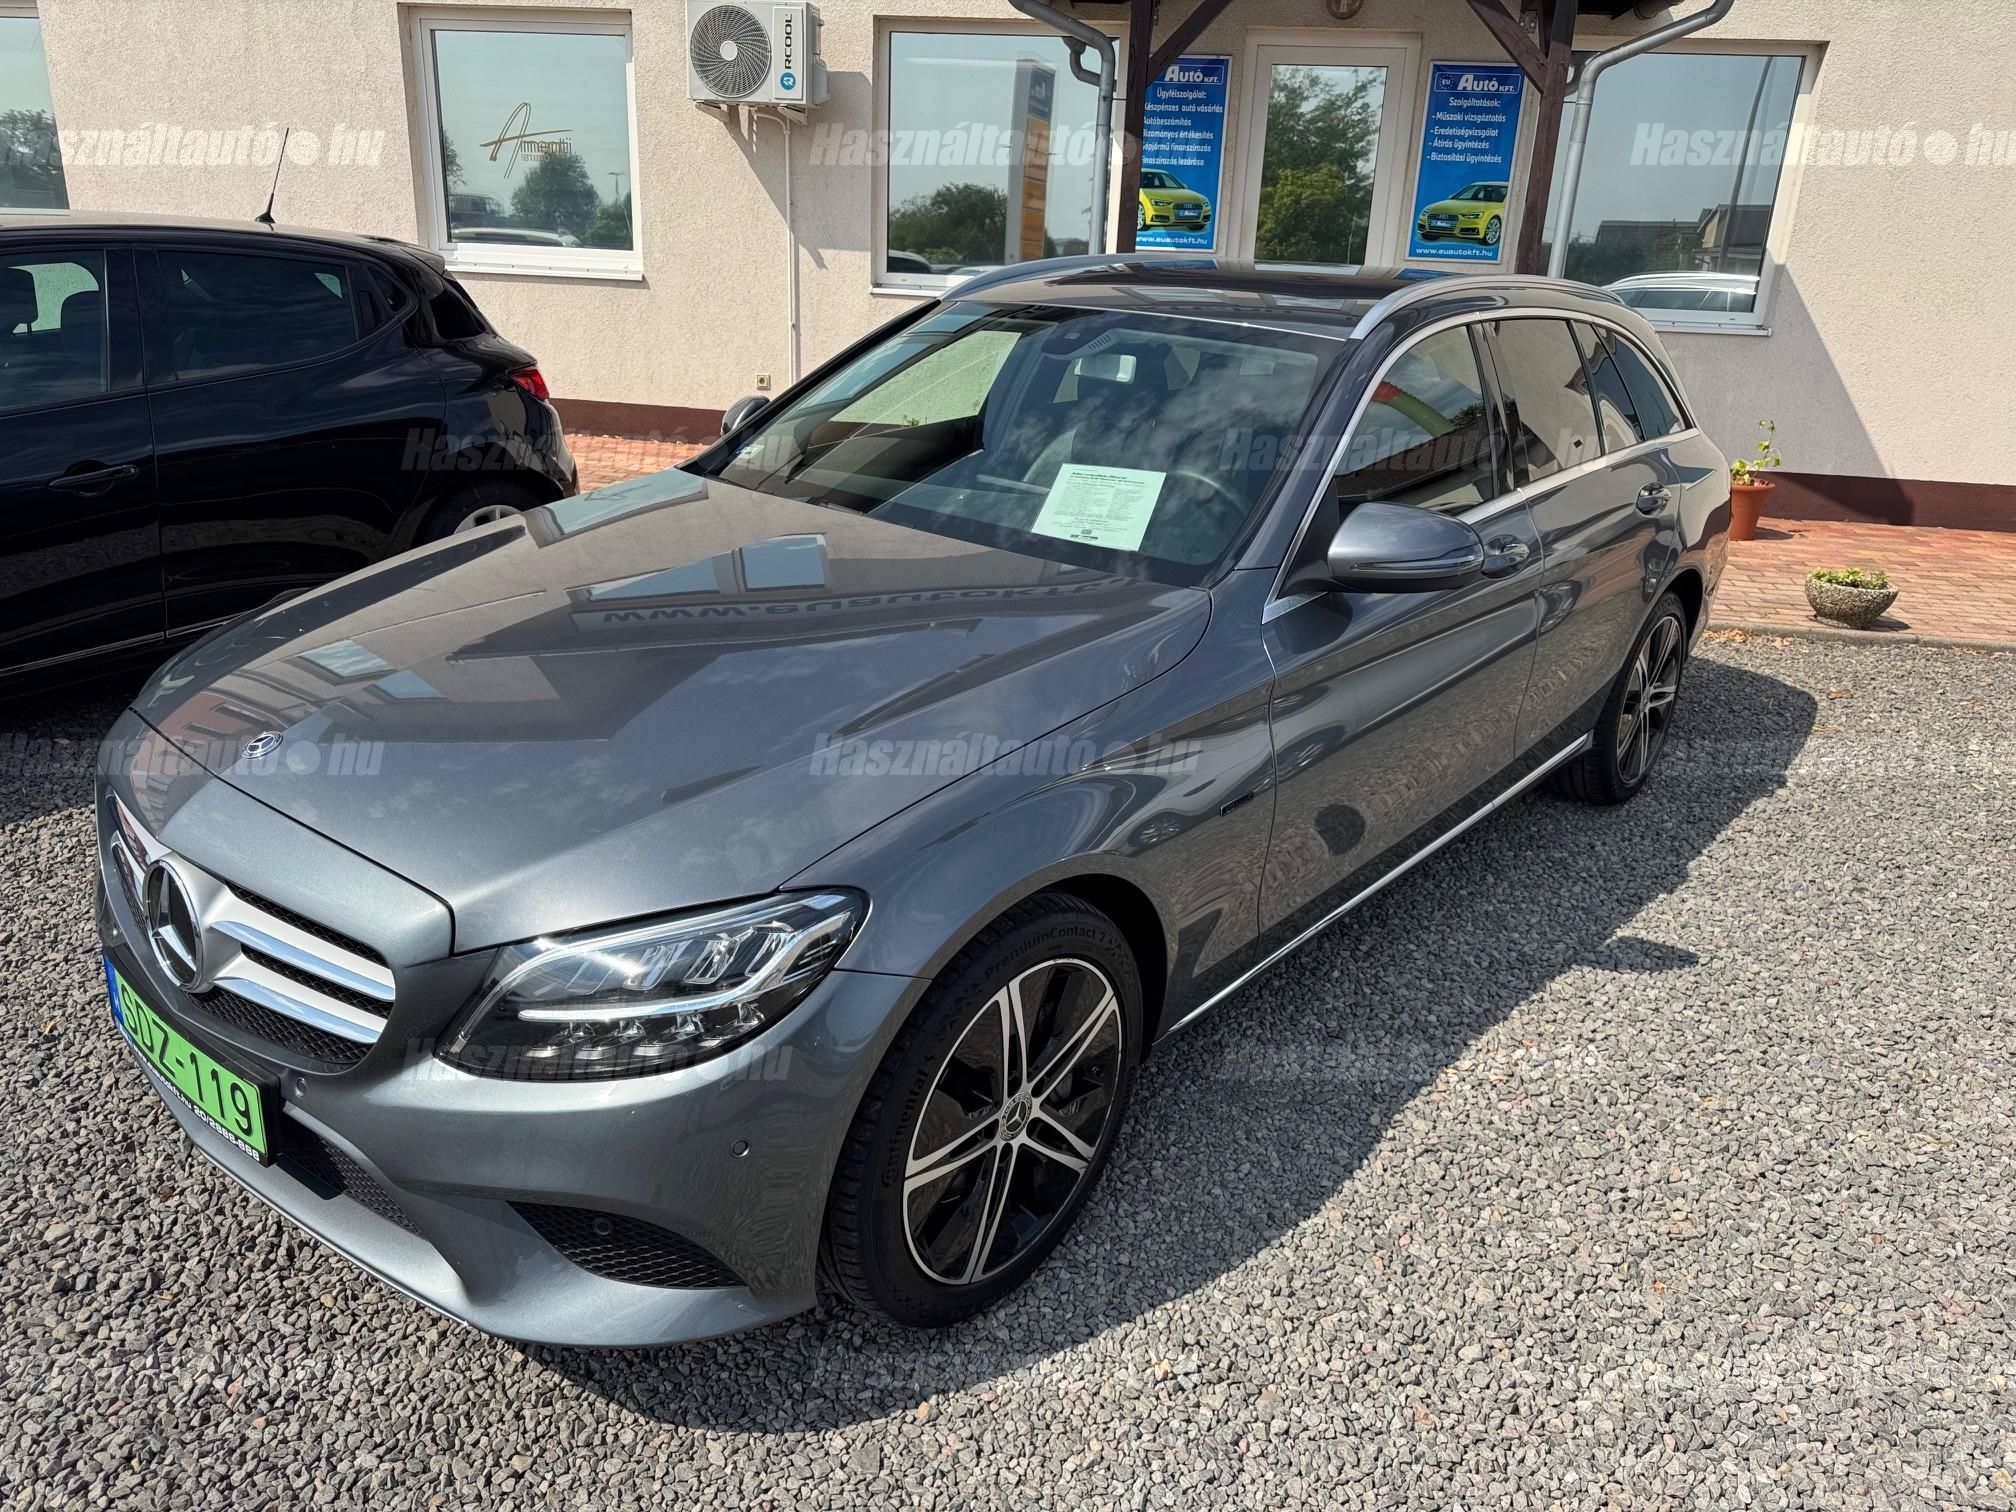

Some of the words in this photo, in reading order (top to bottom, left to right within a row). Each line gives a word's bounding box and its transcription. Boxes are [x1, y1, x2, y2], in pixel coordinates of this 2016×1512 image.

[784, 14, 792, 69] RCOOL
[1164, 65, 1203, 82] Autó
[1457, 74, 1498, 91] Autó
[1449, 97, 1501, 108] Szolgáltatások:
[1416, 248, 1493, 257] www.euautokft.hu
[121, 983, 253, 1137] SDZ-119
